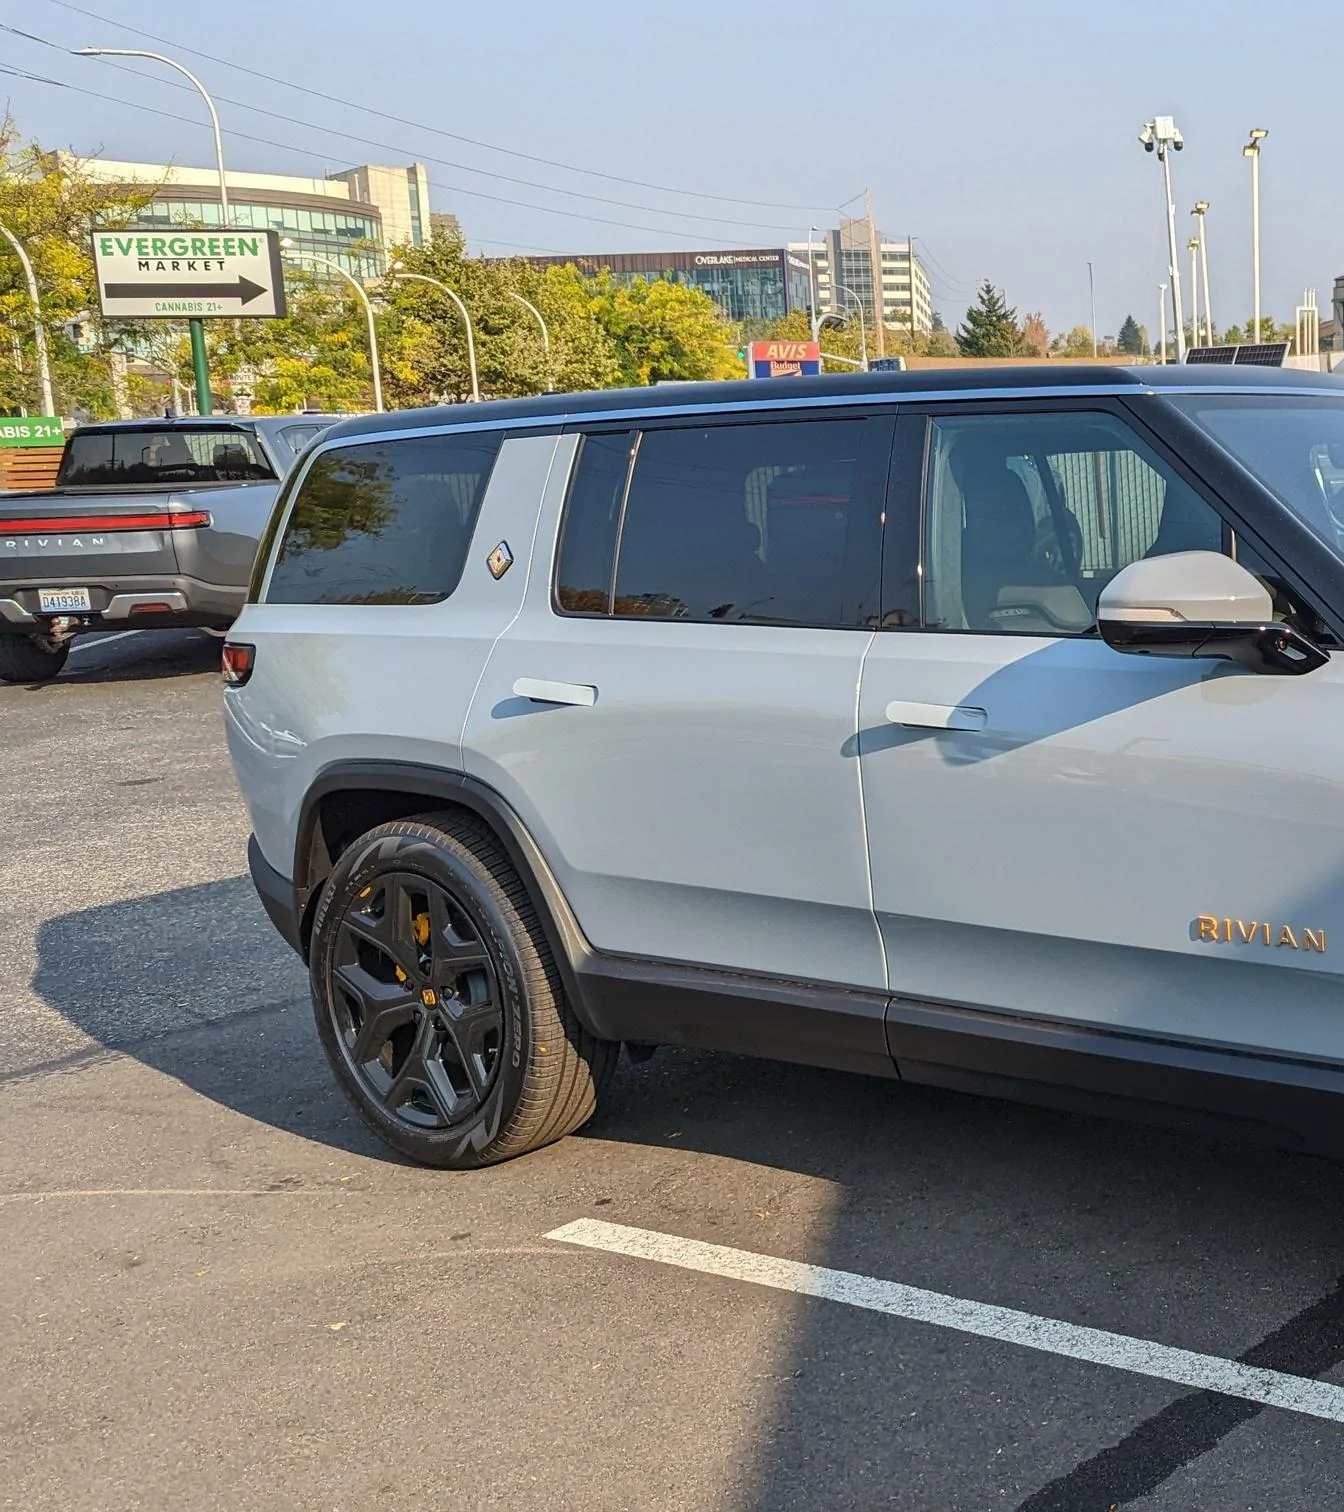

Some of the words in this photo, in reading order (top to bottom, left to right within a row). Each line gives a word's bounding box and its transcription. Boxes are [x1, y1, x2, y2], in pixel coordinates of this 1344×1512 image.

[100, 237, 259, 257] EVERGREEN
[138, 260, 225, 271] MARKET
[695, 255, 734, 265] OVERLAKE
[155, 302, 203, 312] CANNABIS
[207, 302, 223, 311] 21+
[766, 344, 807, 359] AVIS
[772, 361, 801, 371] Budget
[35, 425, 61, 437] 21+
[6, 538, 104, 549] RIVIAN
[42, 595, 87, 608] D41938A
[1197, 915, 1325, 952] RIVIAN
